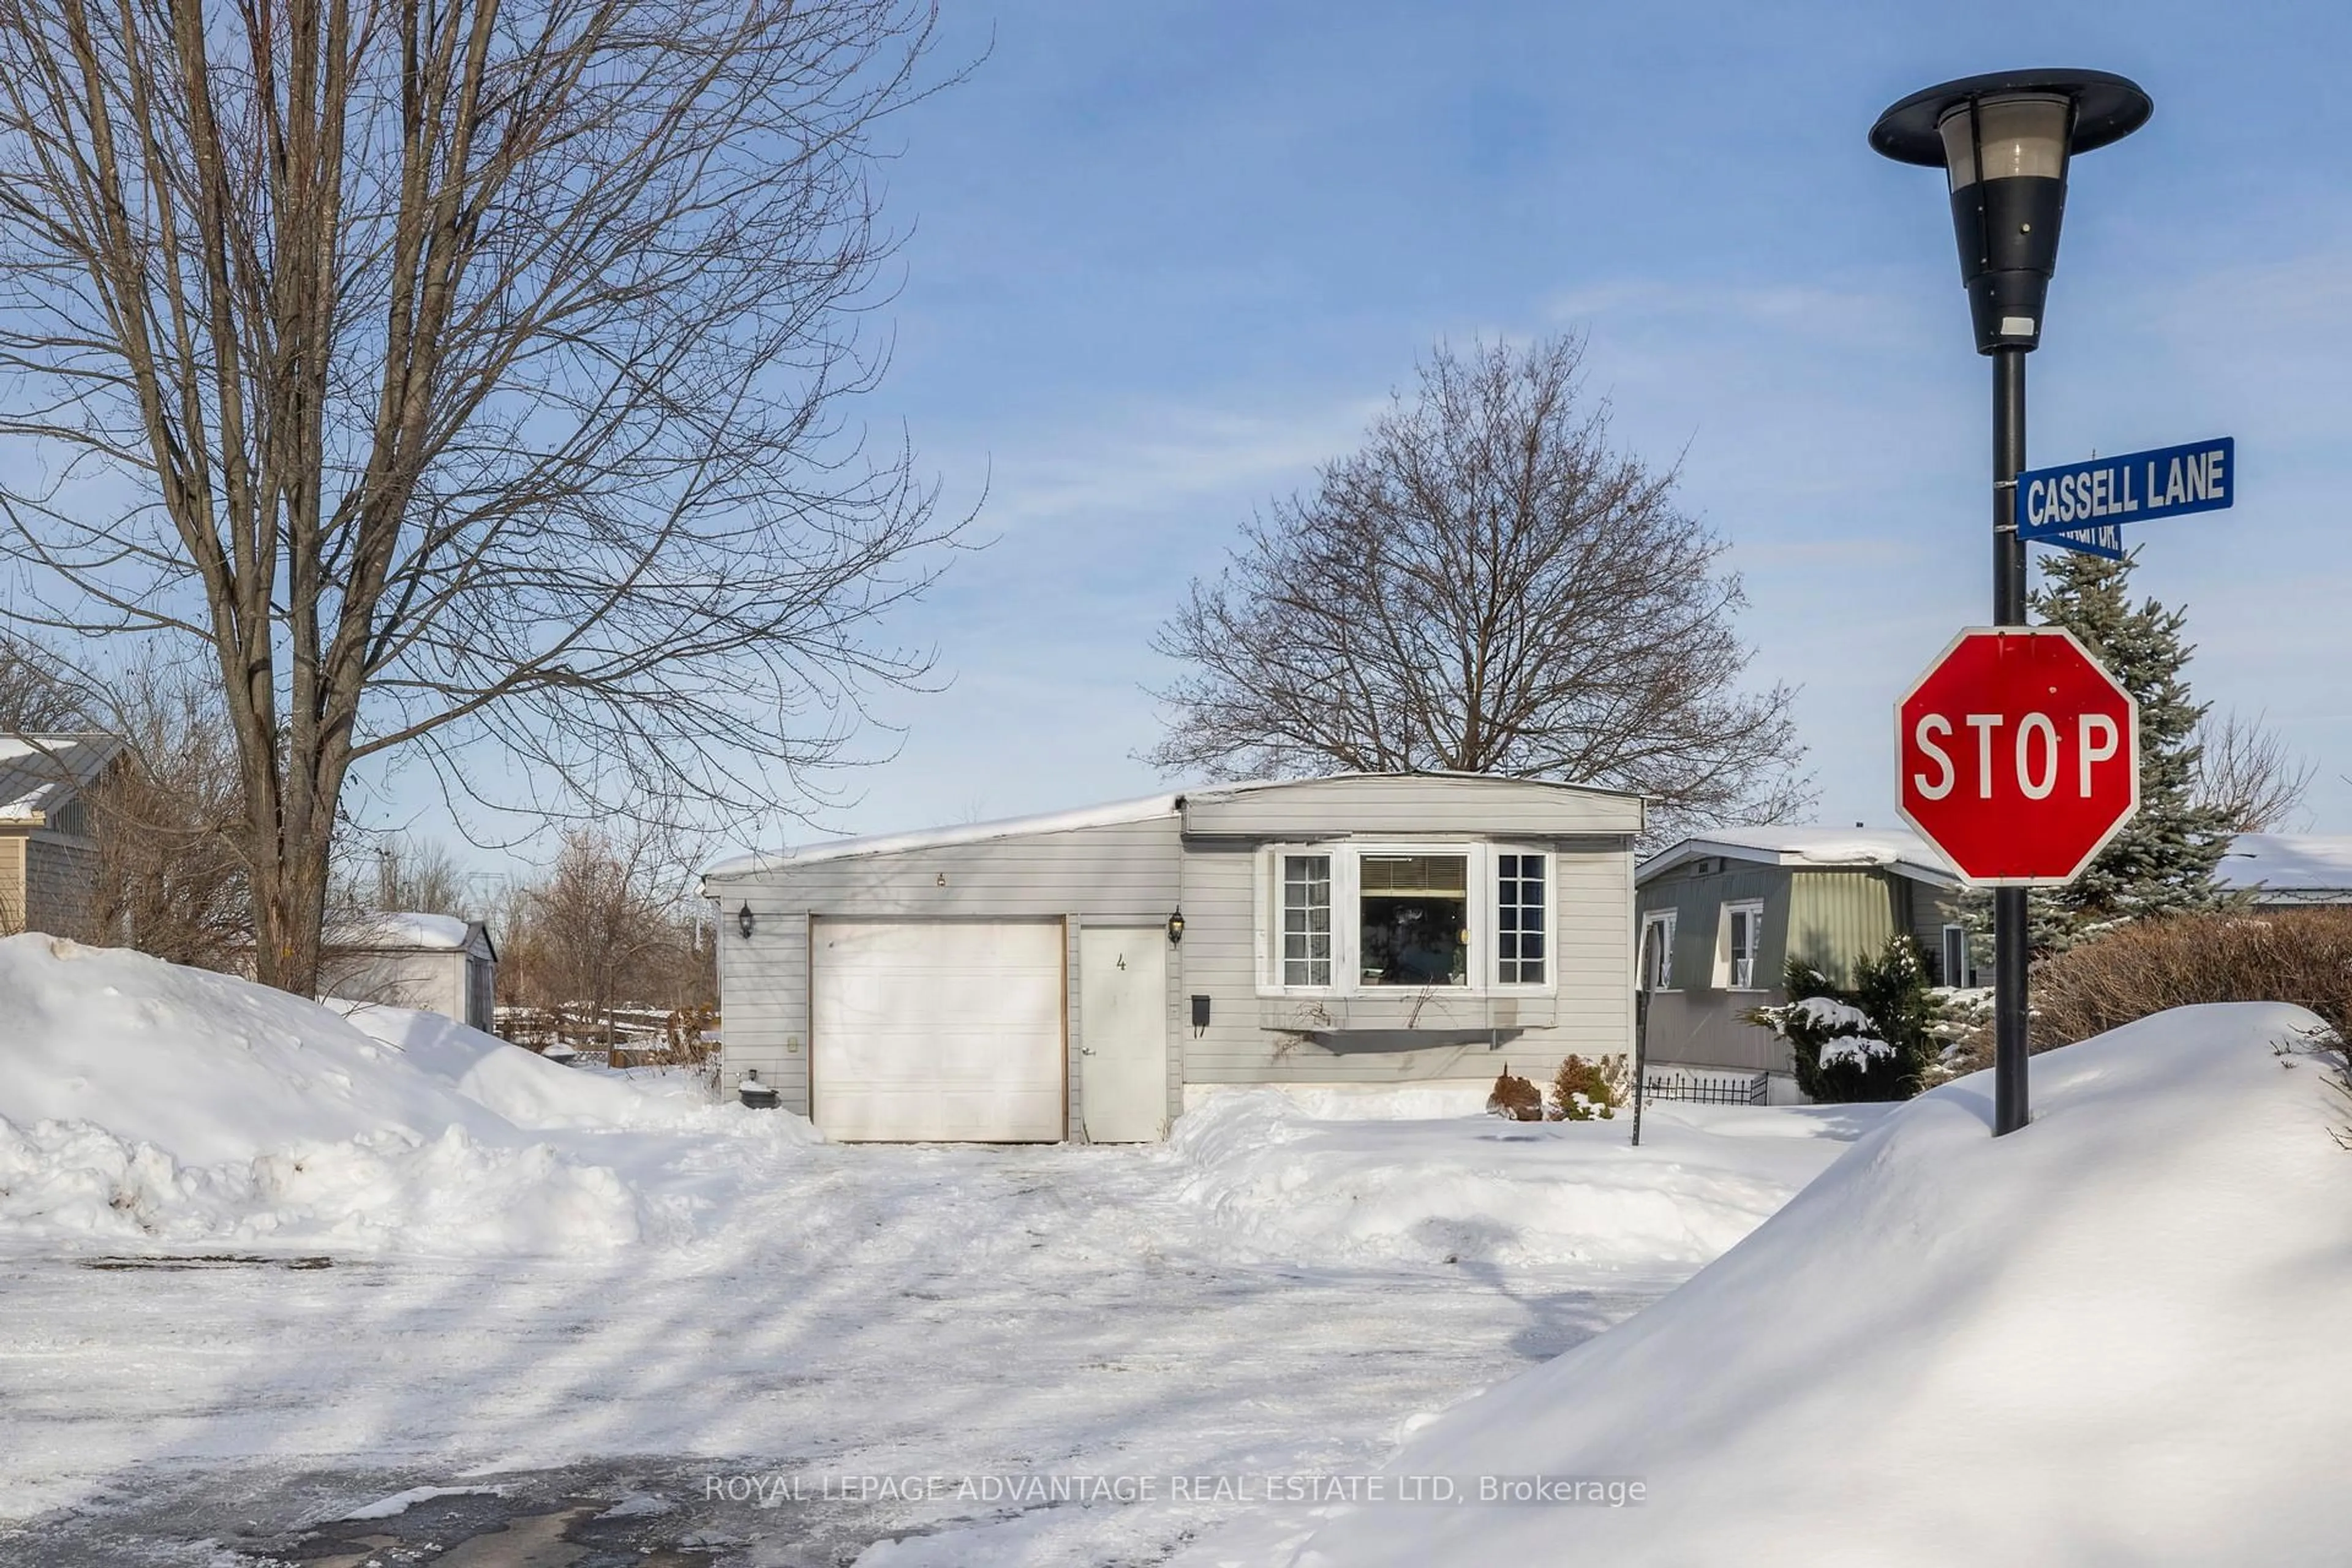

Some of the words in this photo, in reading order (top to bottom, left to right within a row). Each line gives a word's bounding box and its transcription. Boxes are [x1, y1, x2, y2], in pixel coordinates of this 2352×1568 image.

[2027, 466, 2138, 527] CASSELL
[2147, 450, 2225, 508] LANE
[1914, 712, 2119, 801] STOP
[1117, 953, 1126, 971] 4
